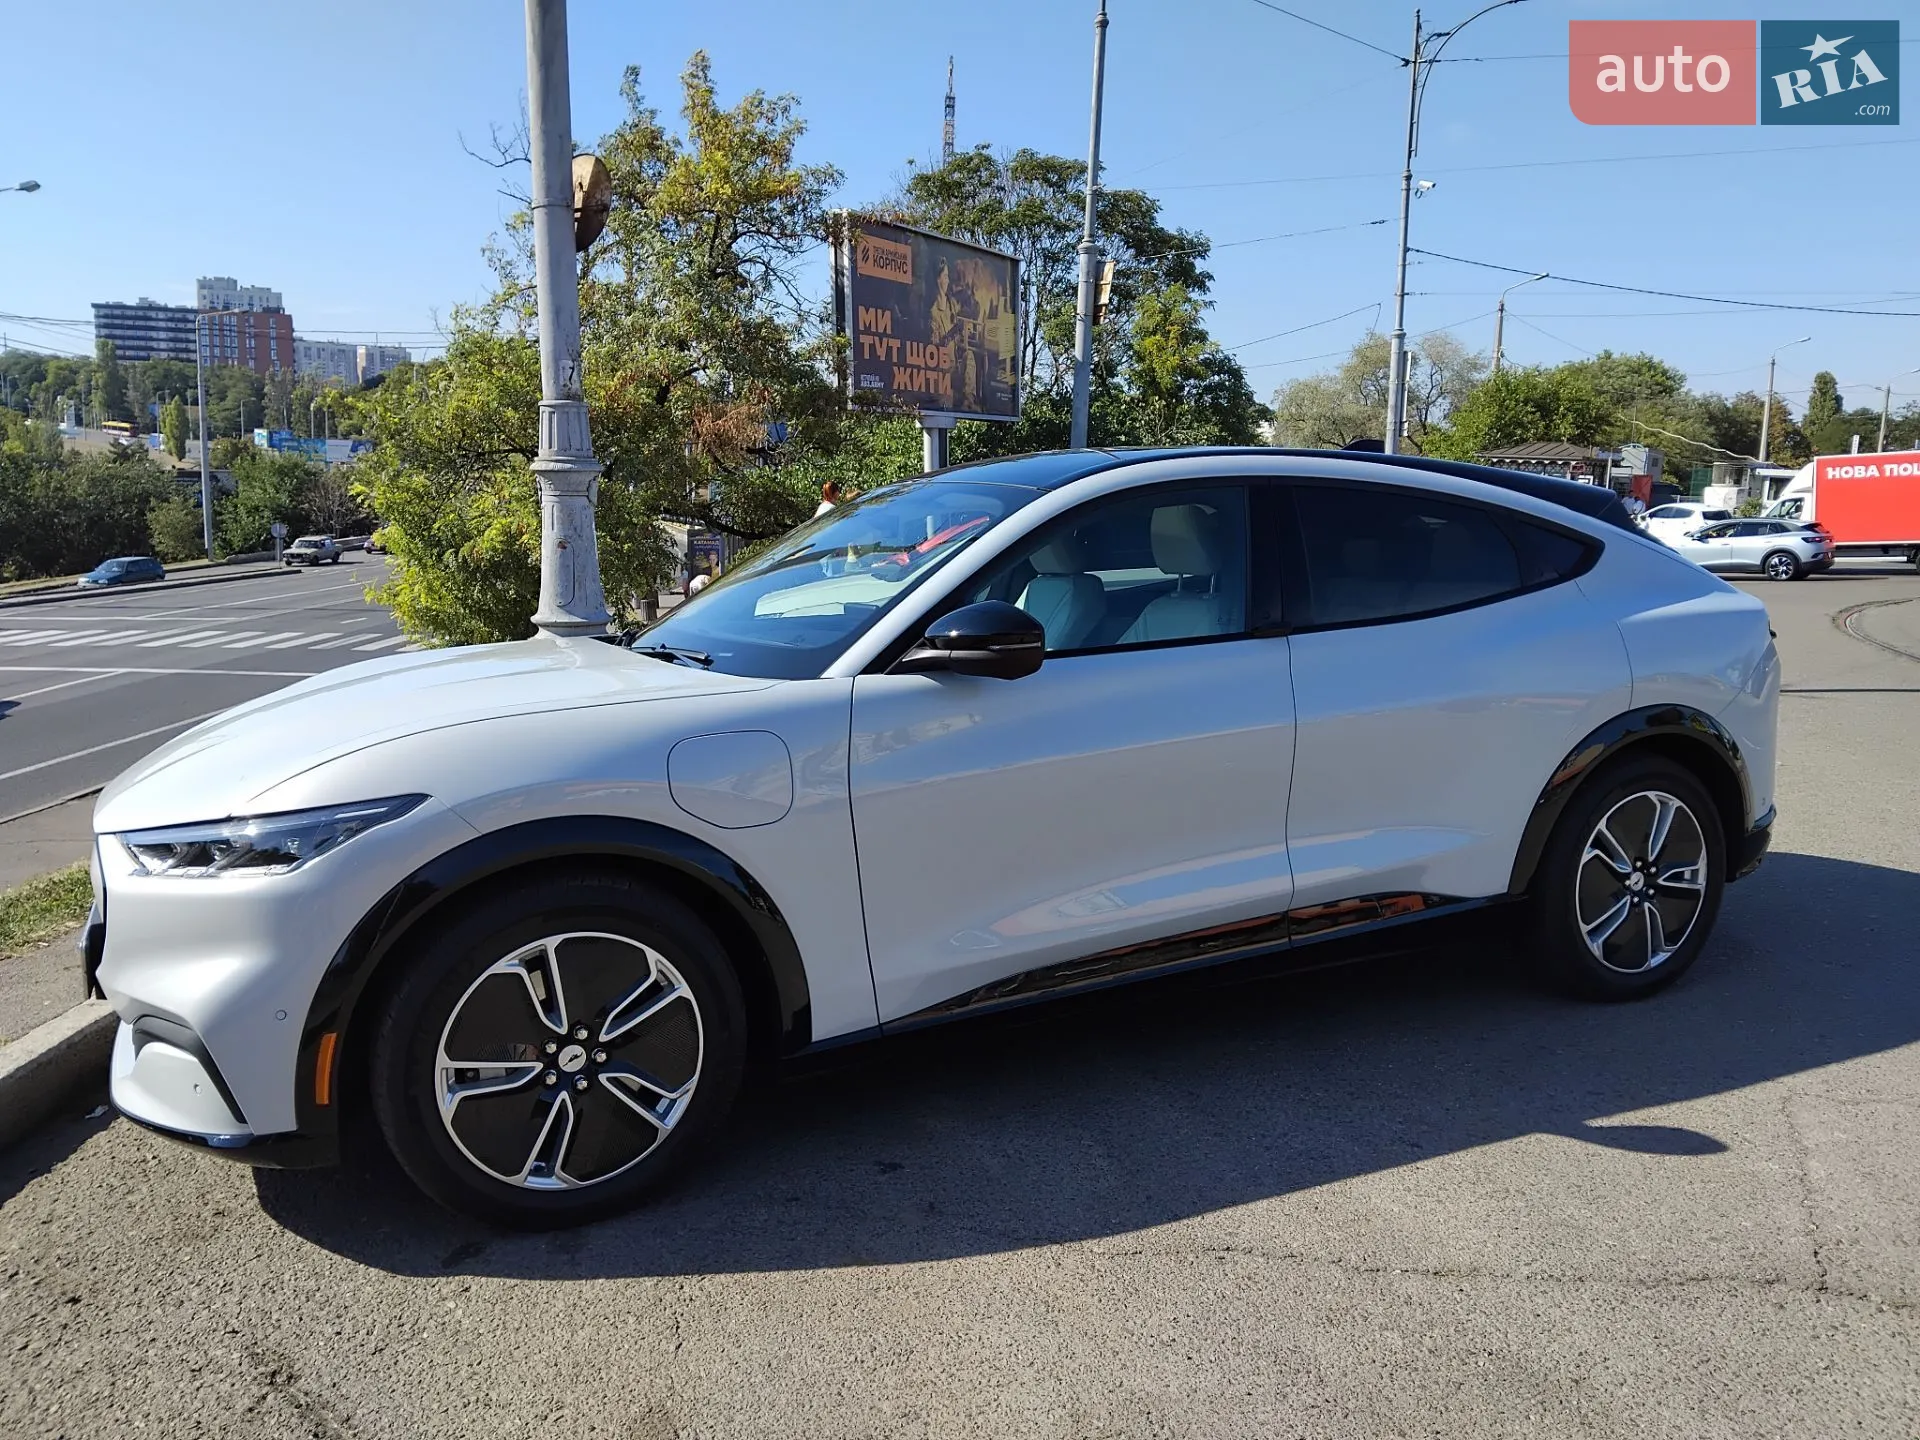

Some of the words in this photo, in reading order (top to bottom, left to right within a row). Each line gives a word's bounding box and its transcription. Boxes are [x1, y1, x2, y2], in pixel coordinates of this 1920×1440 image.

[872, 253, 908, 274] КОРПУС
[858, 305, 892, 334] МИ
[860, 334, 900, 363] ТУТ
[906, 340, 953, 369] ЩОБ
[892, 366, 952, 396] ЖИТИ
[1826, 464, 1880, 480] НОВА
